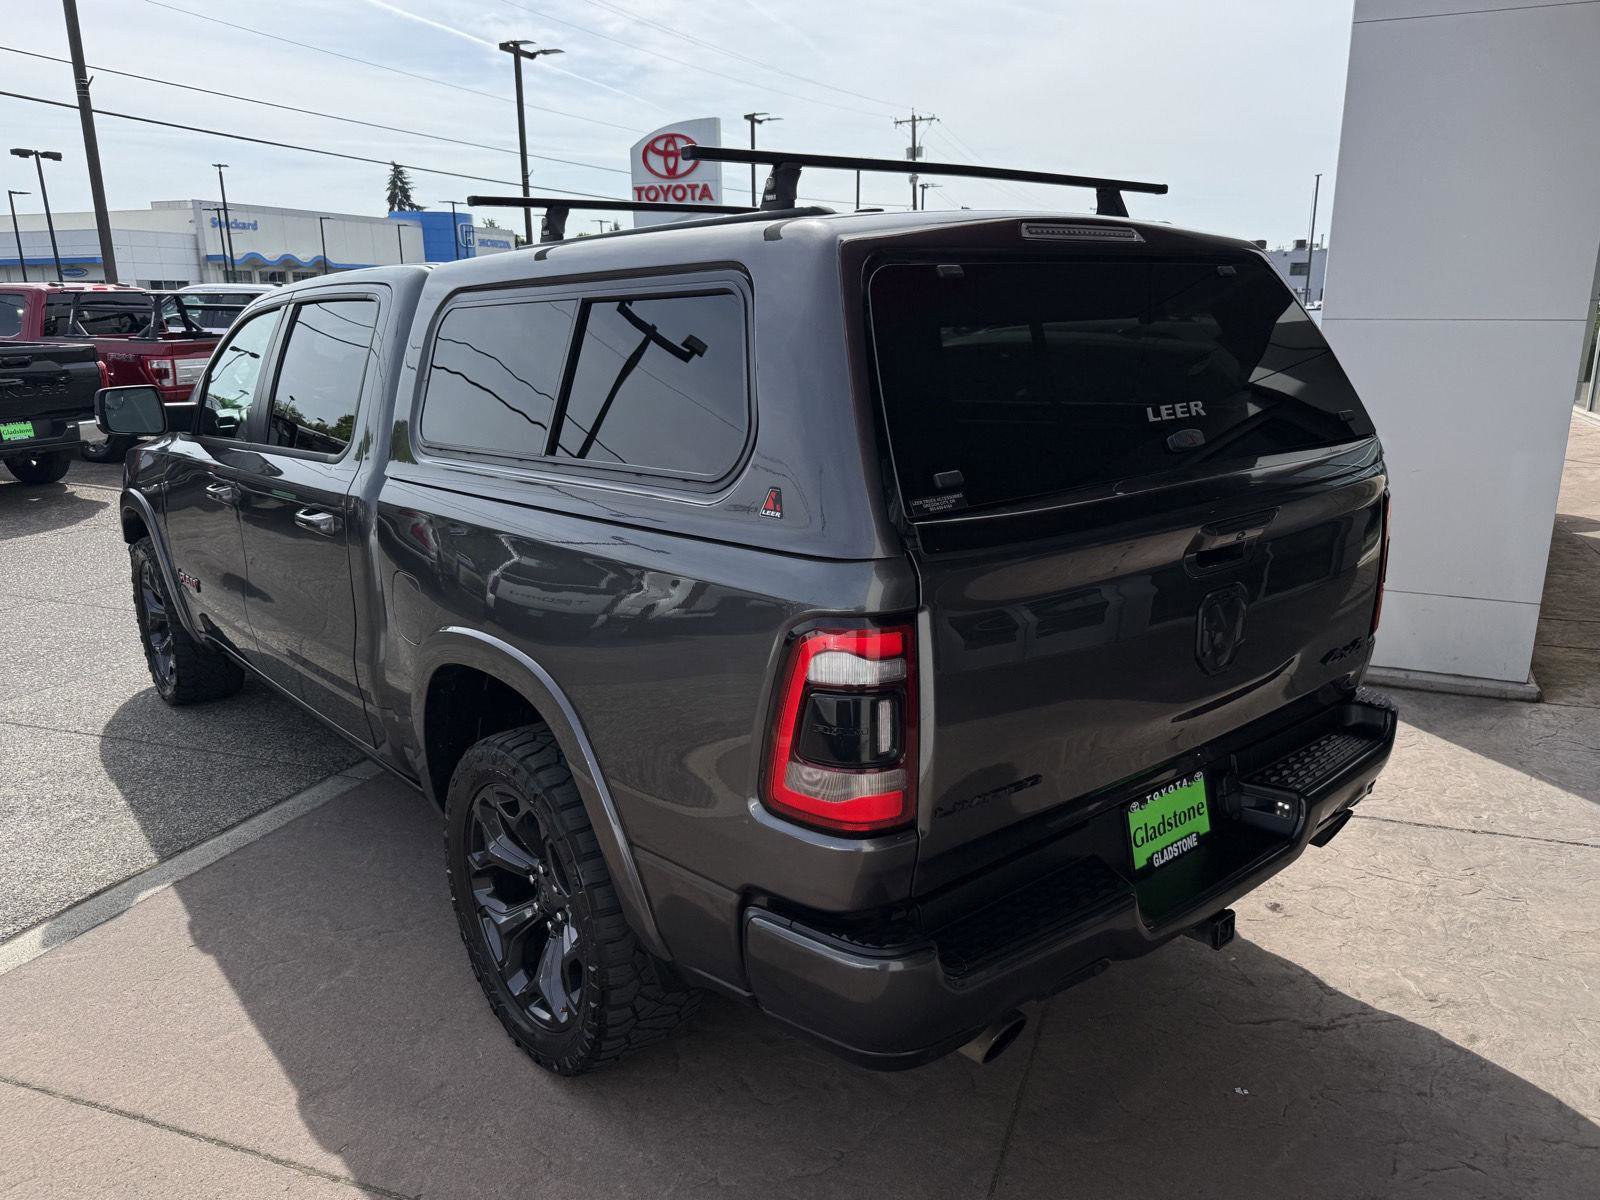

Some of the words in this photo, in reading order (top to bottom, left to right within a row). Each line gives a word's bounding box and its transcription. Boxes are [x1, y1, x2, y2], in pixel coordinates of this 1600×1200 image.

[633, 183, 714, 202] TOYOTA
[1146, 401, 1206, 423] LEER
[2, 428, 33, 436] Gladstone
[761, 509, 781, 518] LEER
[1145, 778, 1188, 804] TOYOTA
[1133, 801, 1205, 849] Gladstone
[1152, 833, 1199, 868] GLADSTONE
